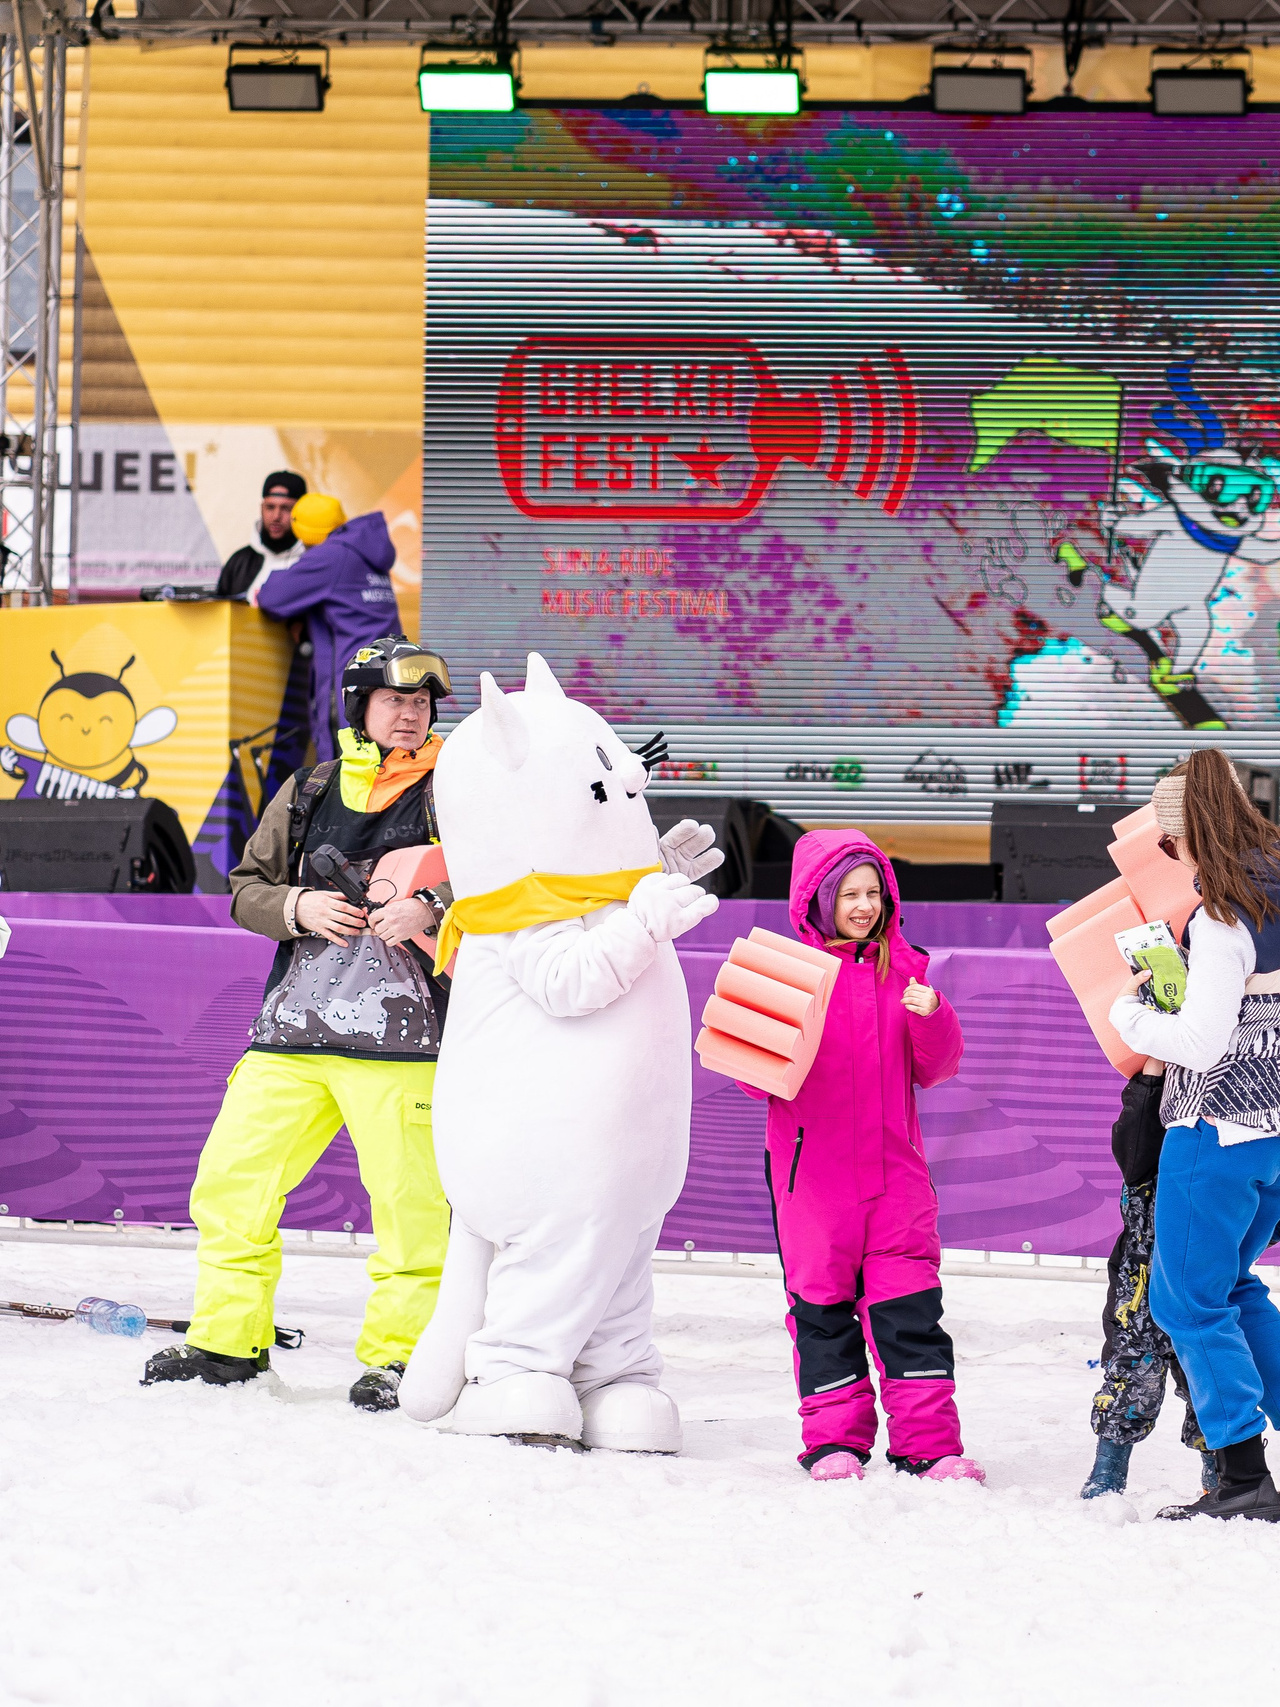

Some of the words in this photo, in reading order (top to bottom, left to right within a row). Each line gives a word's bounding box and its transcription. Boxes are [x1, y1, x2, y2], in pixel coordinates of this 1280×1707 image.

[540, 433, 673, 491] FEST
[541, 547, 592, 577] SUN
[619, 547, 675, 577] RIDE
[541, 588, 615, 617] MUSIC
[621, 588, 733, 618] FESTIVAL
